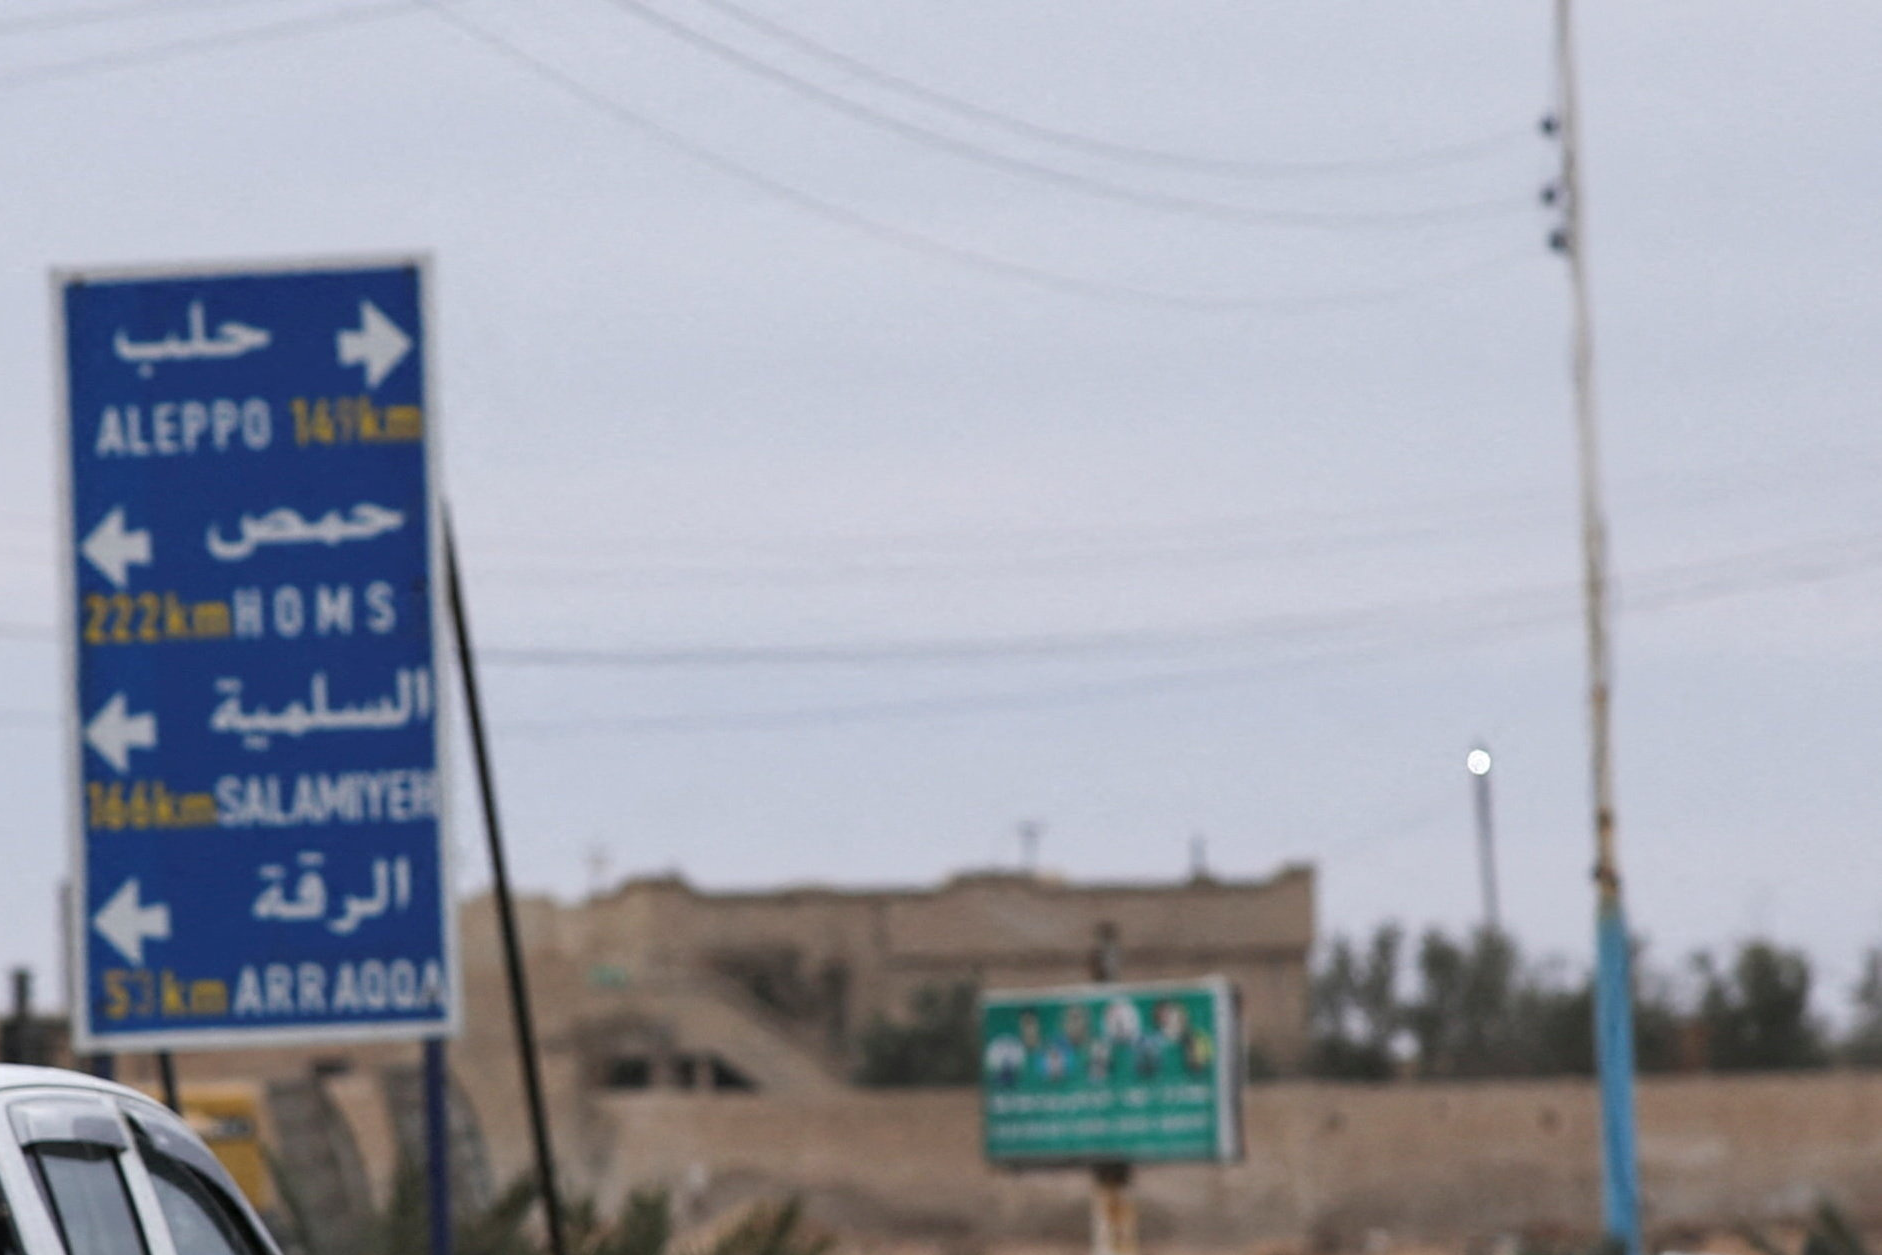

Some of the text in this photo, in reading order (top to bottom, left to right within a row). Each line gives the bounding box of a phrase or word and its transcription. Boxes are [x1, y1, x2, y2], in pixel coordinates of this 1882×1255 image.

[113, 298, 272, 380] حلب
[93, 398, 274, 458] ALEPPO
[205, 502, 406, 561] حمص
[81, 580, 397, 646] 222km HOMS
[208, 667, 432, 752] السلمية
[216, 767, 438, 828] SALAMIYEH
[250, 849, 412, 935] الرقة
